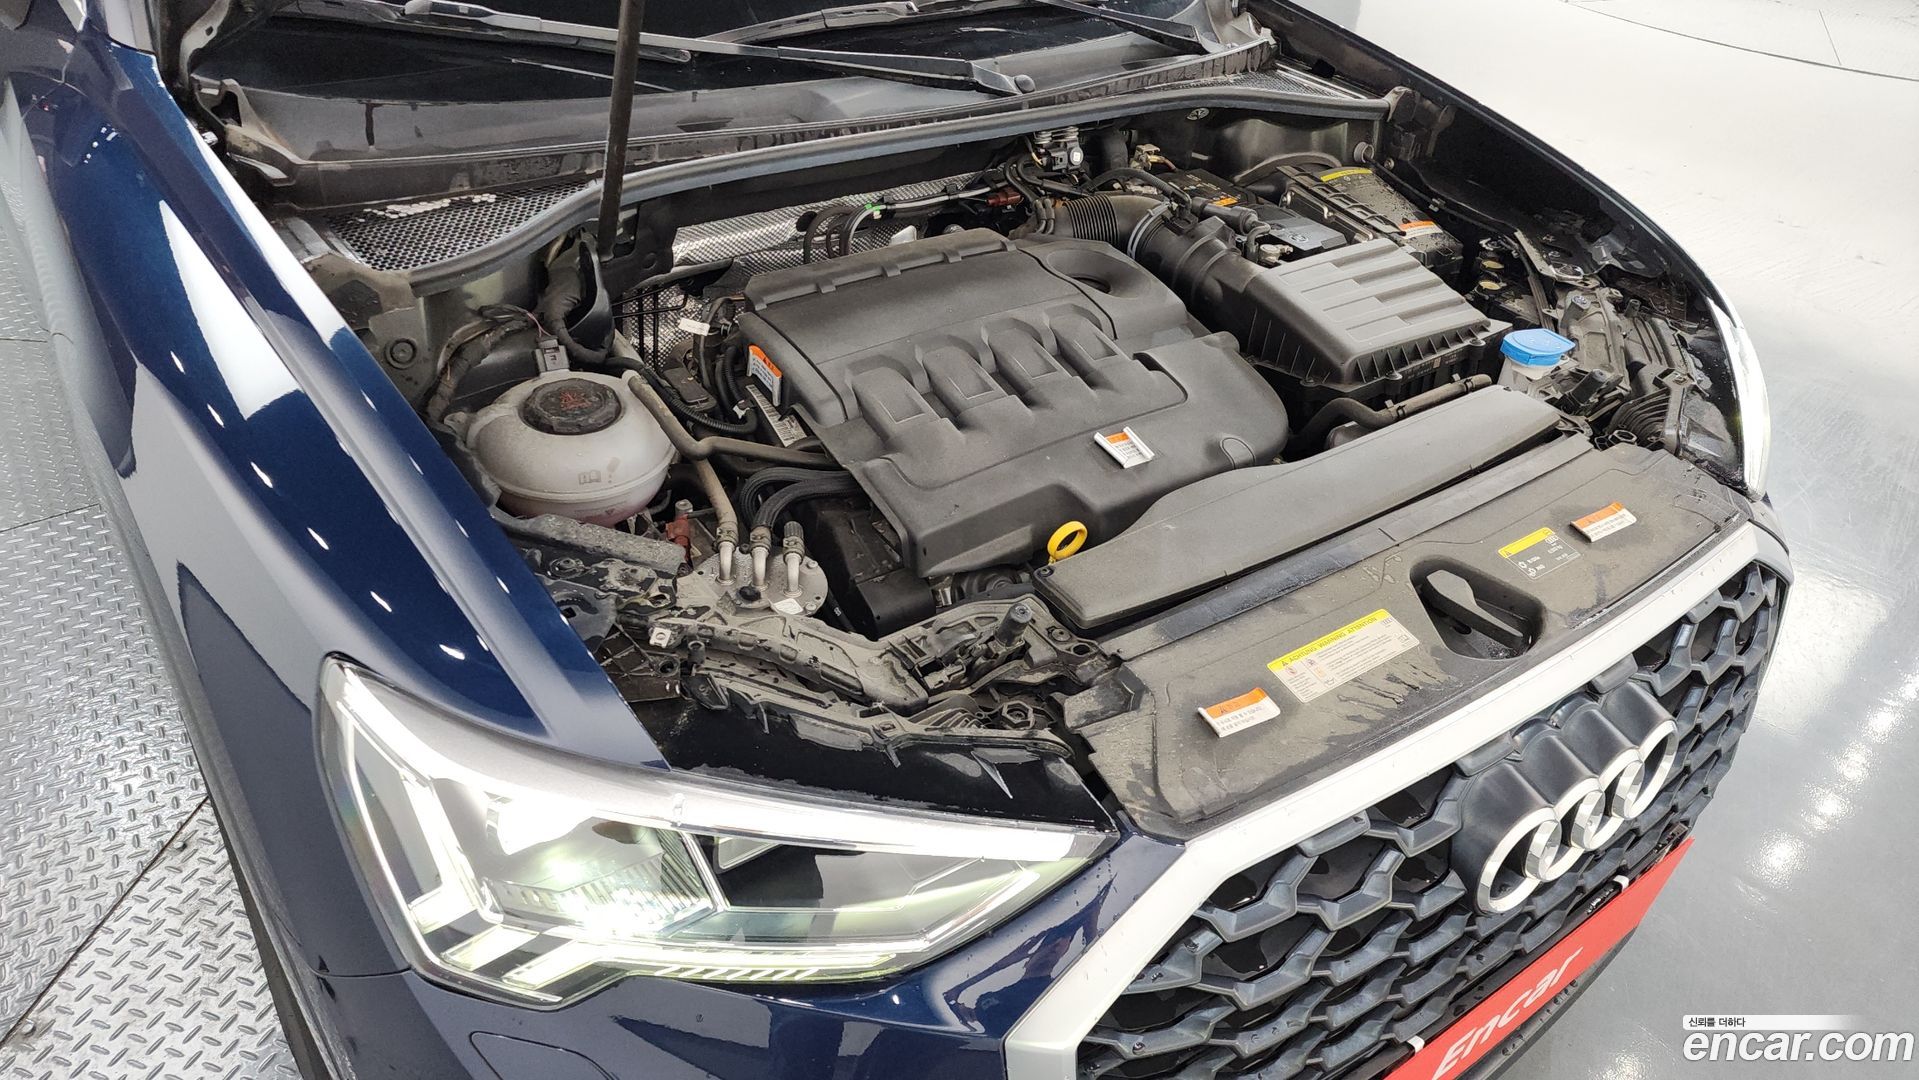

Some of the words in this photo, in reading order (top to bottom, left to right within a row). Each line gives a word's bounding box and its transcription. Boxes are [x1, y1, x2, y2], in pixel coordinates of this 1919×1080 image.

[1289, 646, 1317, 662] ACHTUNG
[1319, 632, 1346, 648] WARNING
[1347, 617, 1378, 634] ATTENTION
[1432, 946, 1584, 1080] Encar
